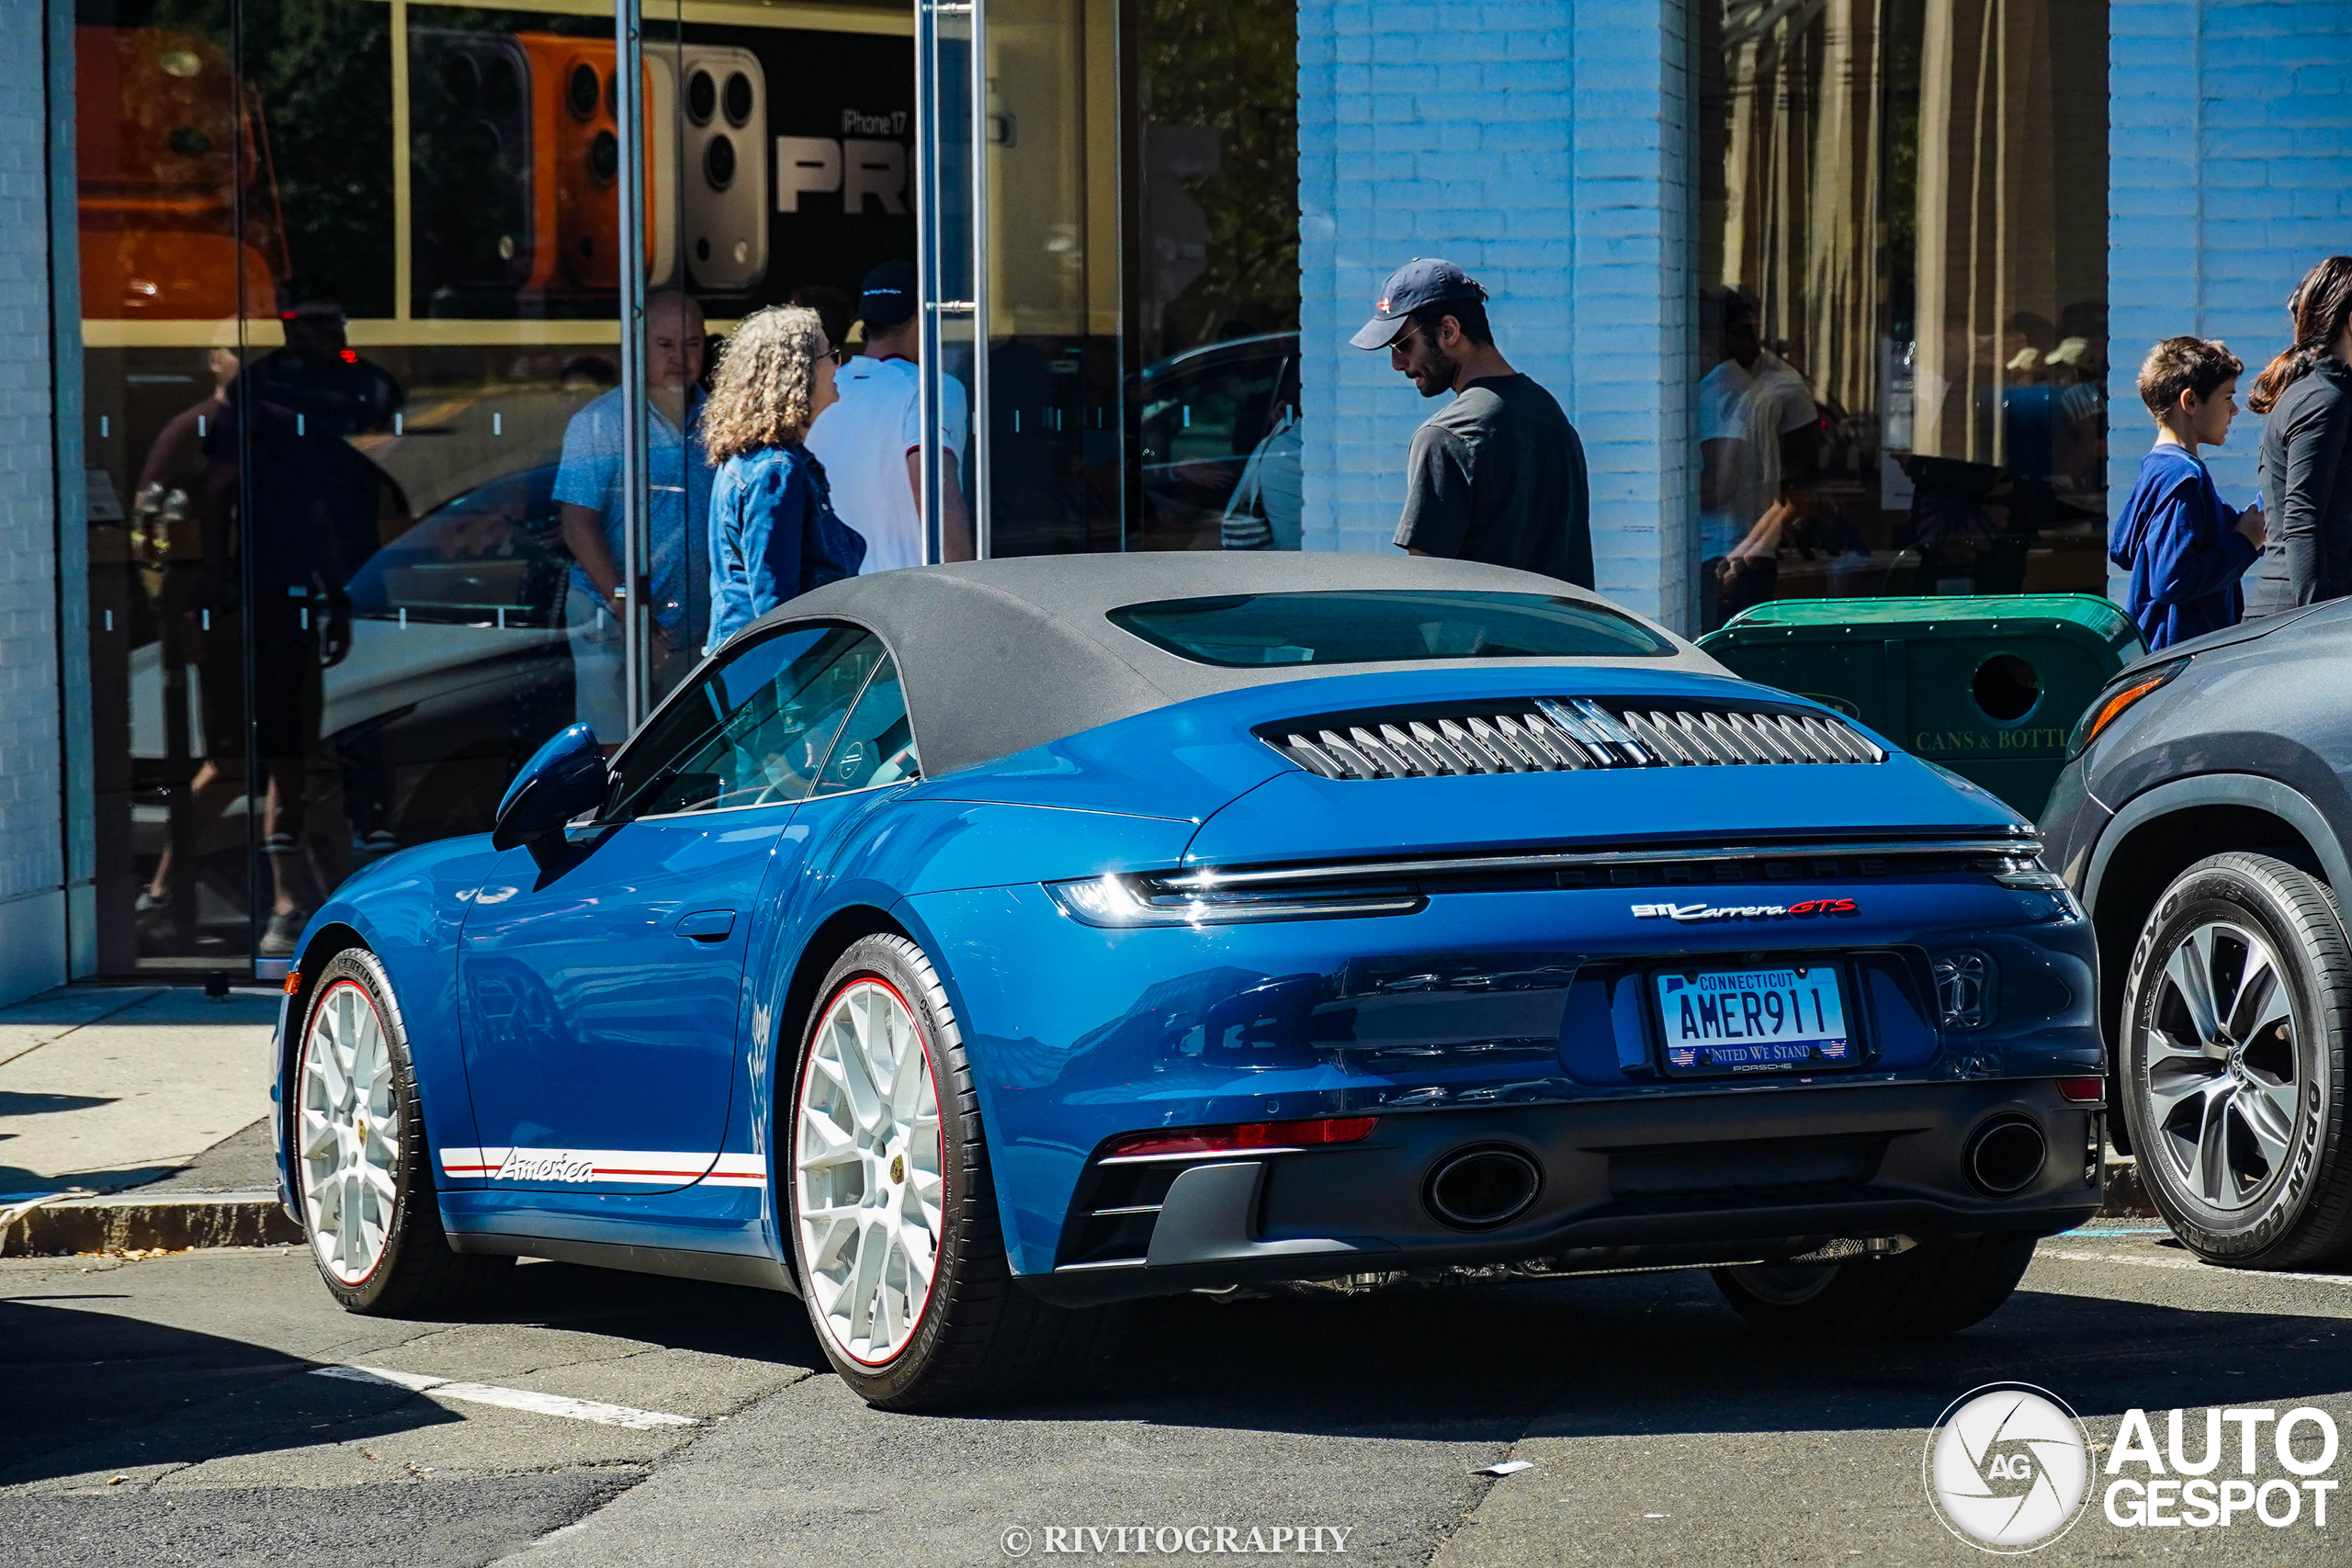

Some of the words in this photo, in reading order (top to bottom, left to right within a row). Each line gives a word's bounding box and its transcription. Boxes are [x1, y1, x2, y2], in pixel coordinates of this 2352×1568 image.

[842, 109, 890, 134] iPhone
[890, 111, 908, 134] 17
[776, 135, 917, 214] PR
[1916, 732, 1973, 751] CANS
[1980, 737, 1991, 750] &
[1555, 860, 1886, 888] PORSCHE
[1631, 903, 1676, 917] 911
[1672, 904, 1787, 919] Carrera
[1788, 898, 1858, 913] GTS
[2125, 893, 2178, 1005] TOYO
[1700, 973, 1793, 991] CONNECTICUT
[1680, 988, 1826, 1040] AMER911
[1706, 1048, 1747, 1063] UNITED
[1750, 1046, 1770, 1059] WE
[1774, 1043, 1811, 1058] STAND
[1733, 1063, 1792, 1071] PORSCHE
[2289, 1079, 2321, 1201] OPEN
[494, 1146, 595, 1183] America
[2175, 1203, 2285, 1254] COUNTRY
